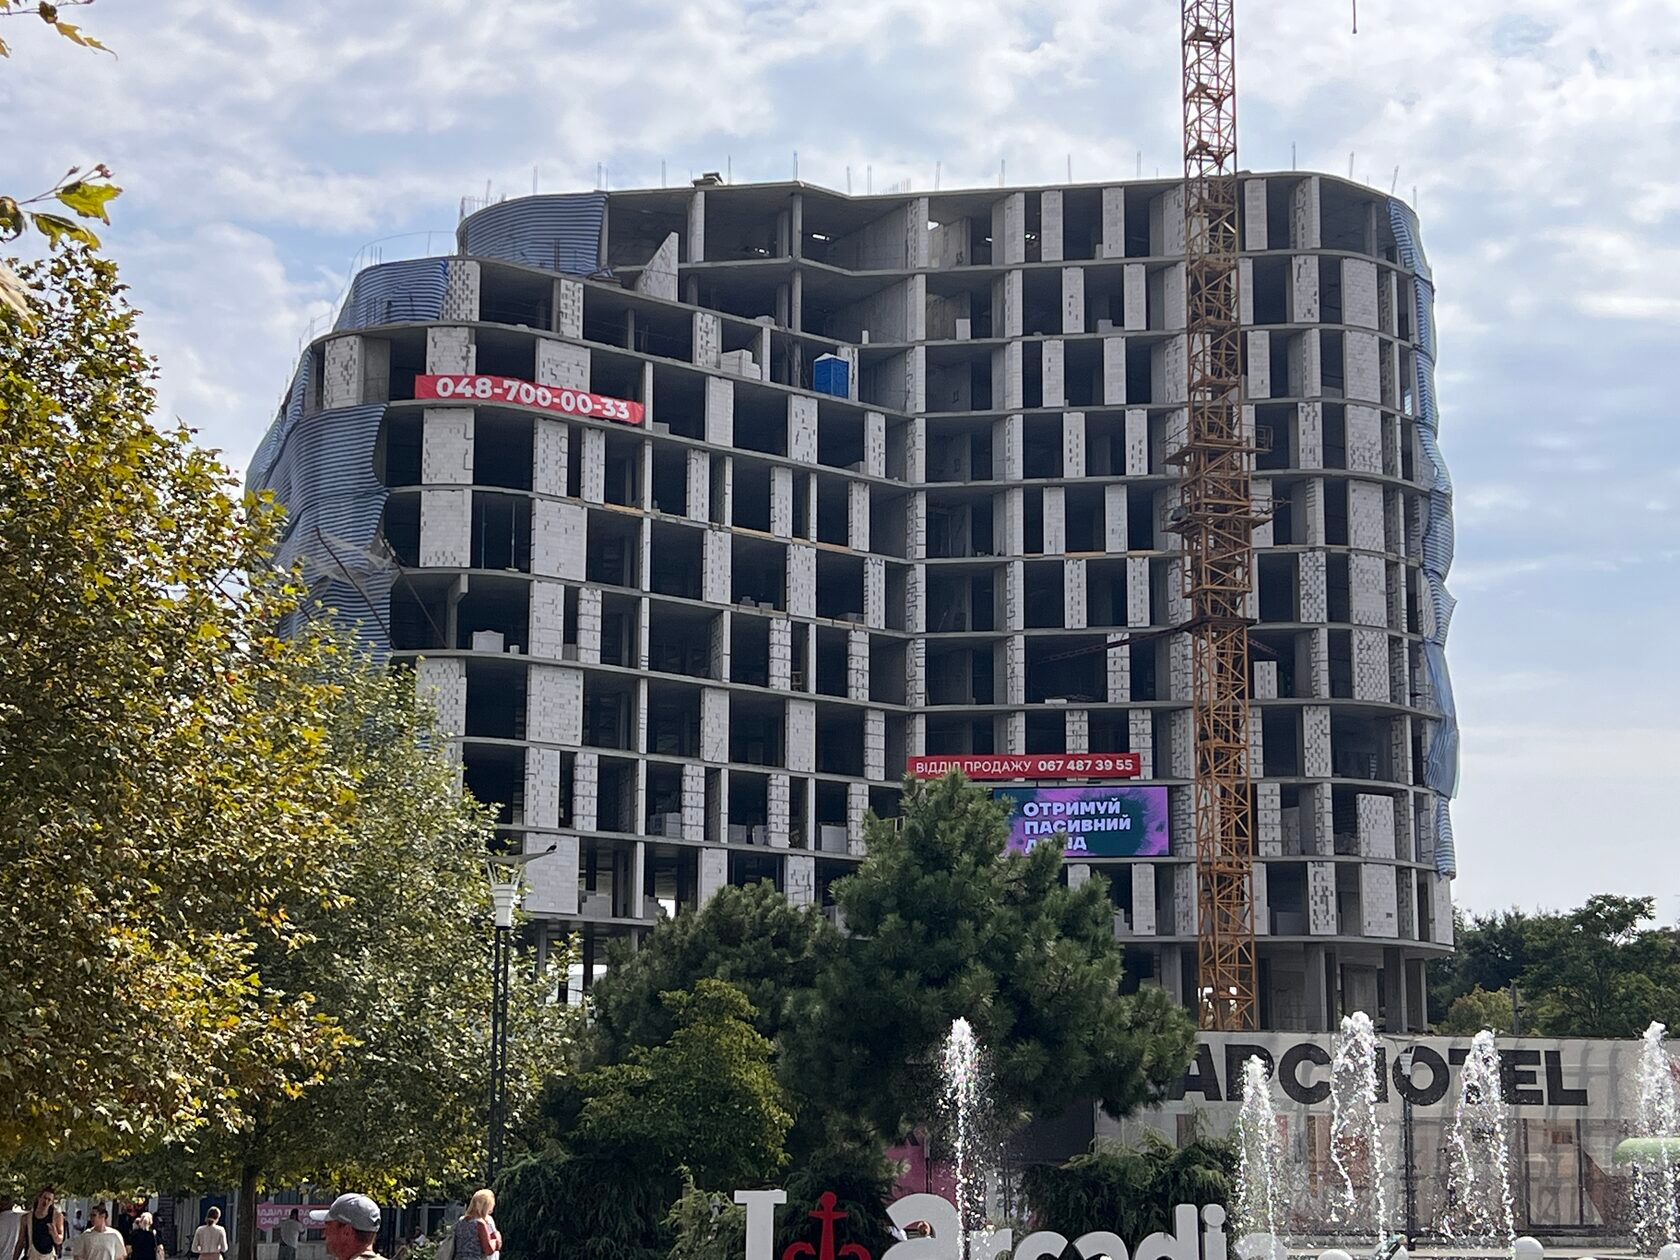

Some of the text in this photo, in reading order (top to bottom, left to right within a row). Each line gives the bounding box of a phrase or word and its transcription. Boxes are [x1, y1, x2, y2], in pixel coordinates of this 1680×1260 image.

[436, 376, 630, 420] 048-700-00-33
[964, 761, 1032, 774] ПРОДАЖУ
[1037, 760, 1064, 772] 067
[1066, 760, 1093, 771] 487
[1095, 760, 1113, 771] 39
[1116, 760, 1133, 771] 55
[1023, 797, 1121, 817] ОТРИМУЙ
[1024, 814, 1132, 835] ПАСИВНИЙ
[1024, 836, 1088, 854] ДІД
